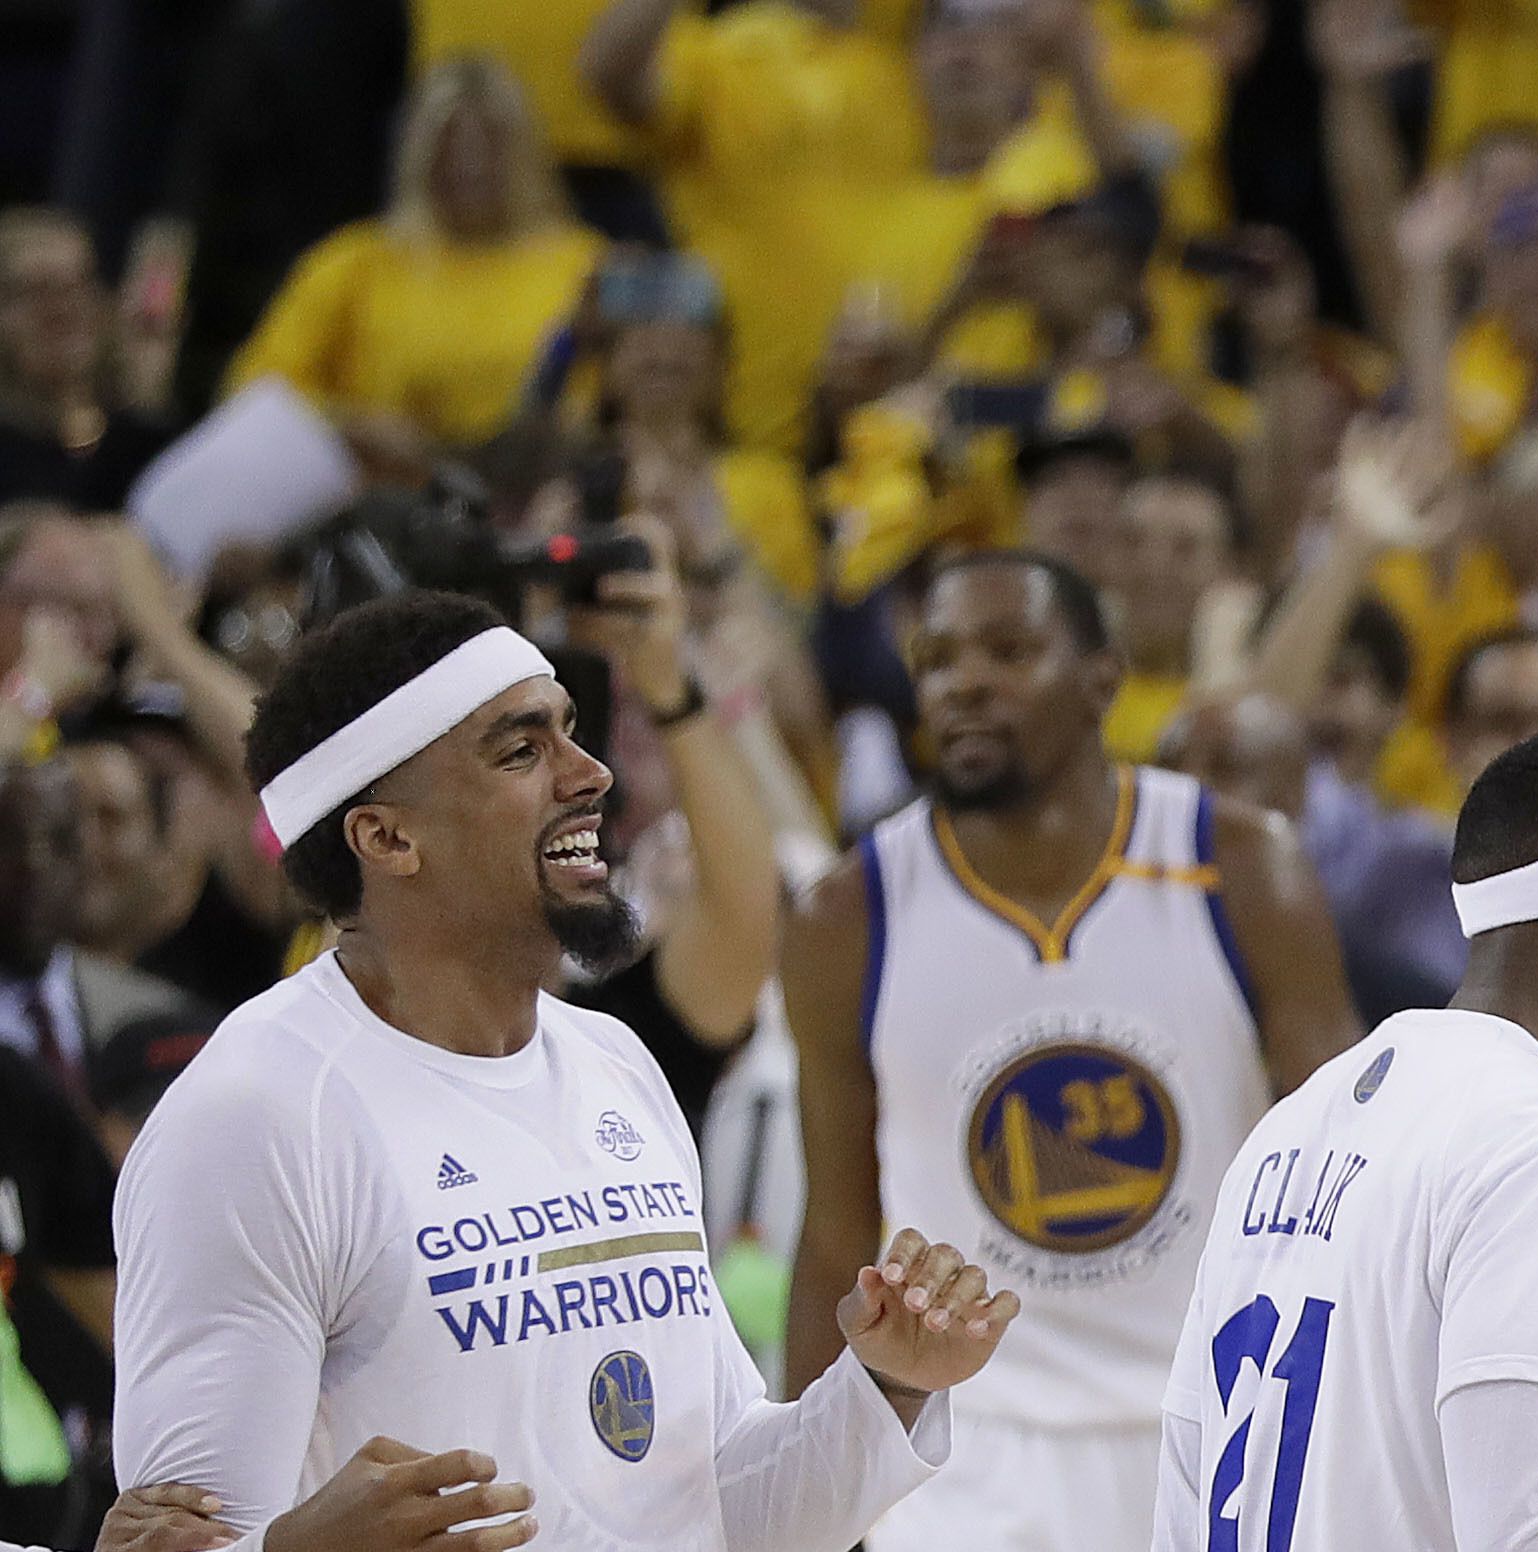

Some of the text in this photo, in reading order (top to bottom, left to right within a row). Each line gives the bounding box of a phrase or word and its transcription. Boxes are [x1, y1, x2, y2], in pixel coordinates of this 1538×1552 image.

[1061, 1073, 1146, 1142] 35
[416, 1183, 694, 1261] GOLDEN STATE
[435, 1265, 711, 1353] WARRIORS
